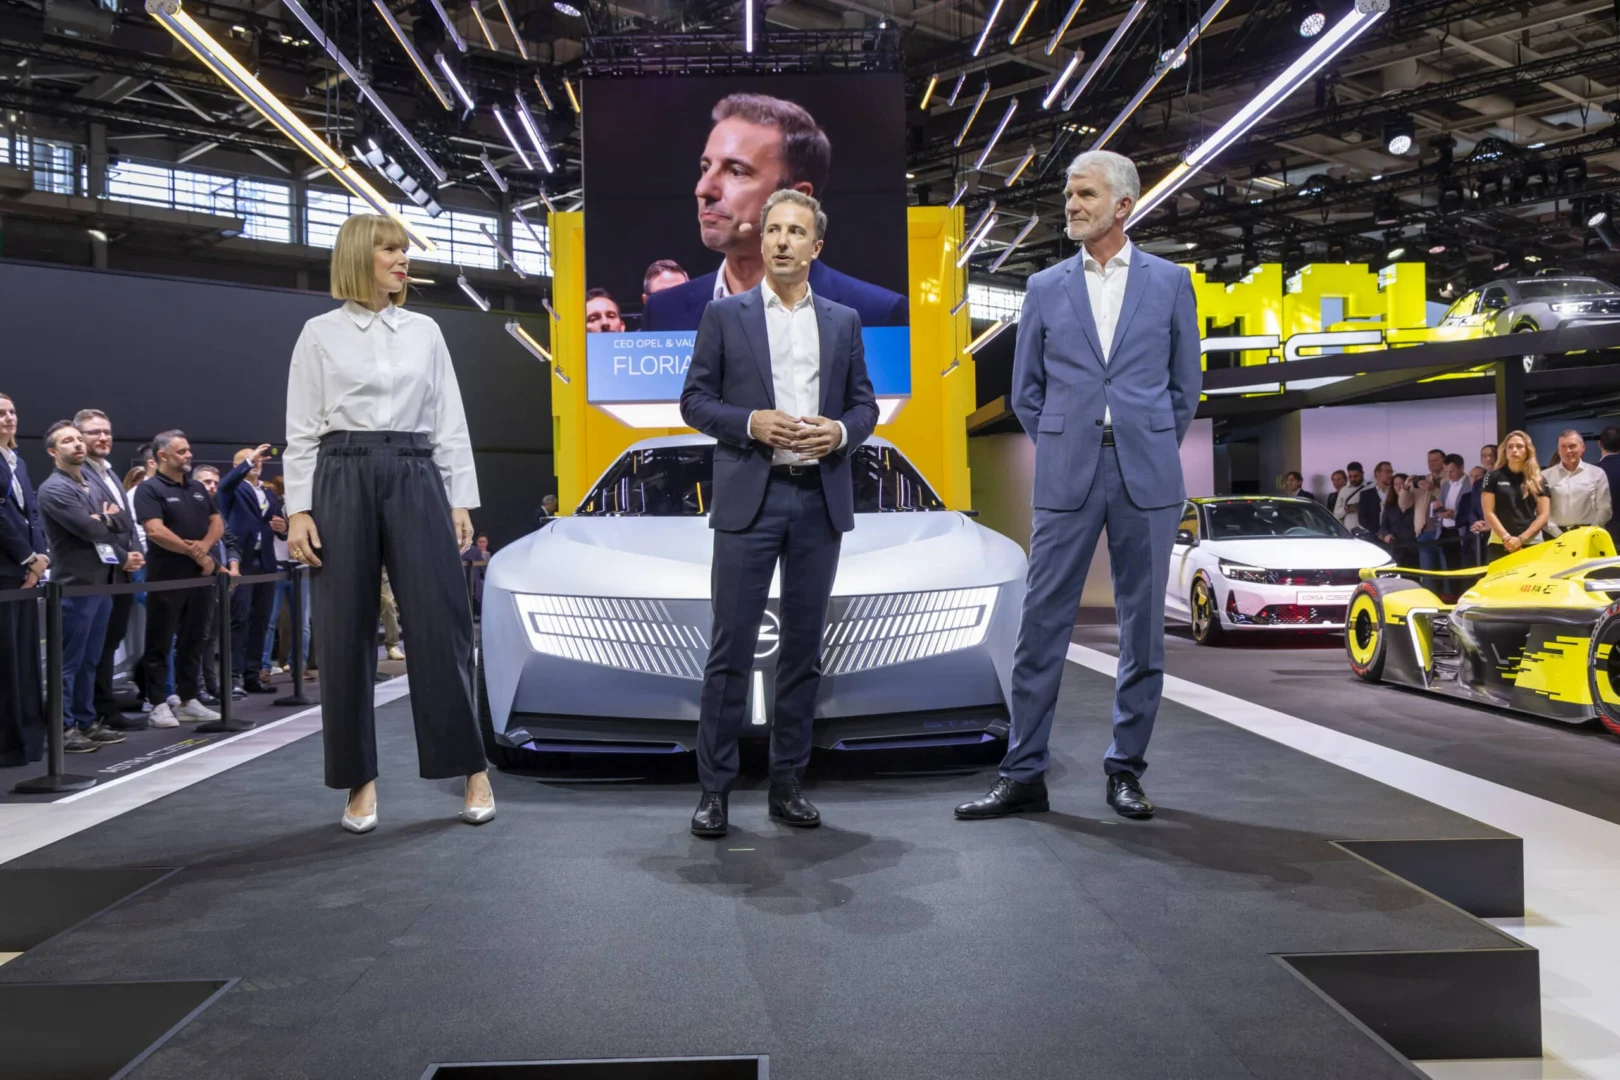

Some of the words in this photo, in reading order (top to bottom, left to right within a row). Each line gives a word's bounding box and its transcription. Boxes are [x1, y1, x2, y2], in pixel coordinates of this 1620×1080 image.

[613, 340, 634, 349] CEO
[636, 338, 663, 348] OPEL
[665, 338, 674, 348] &
